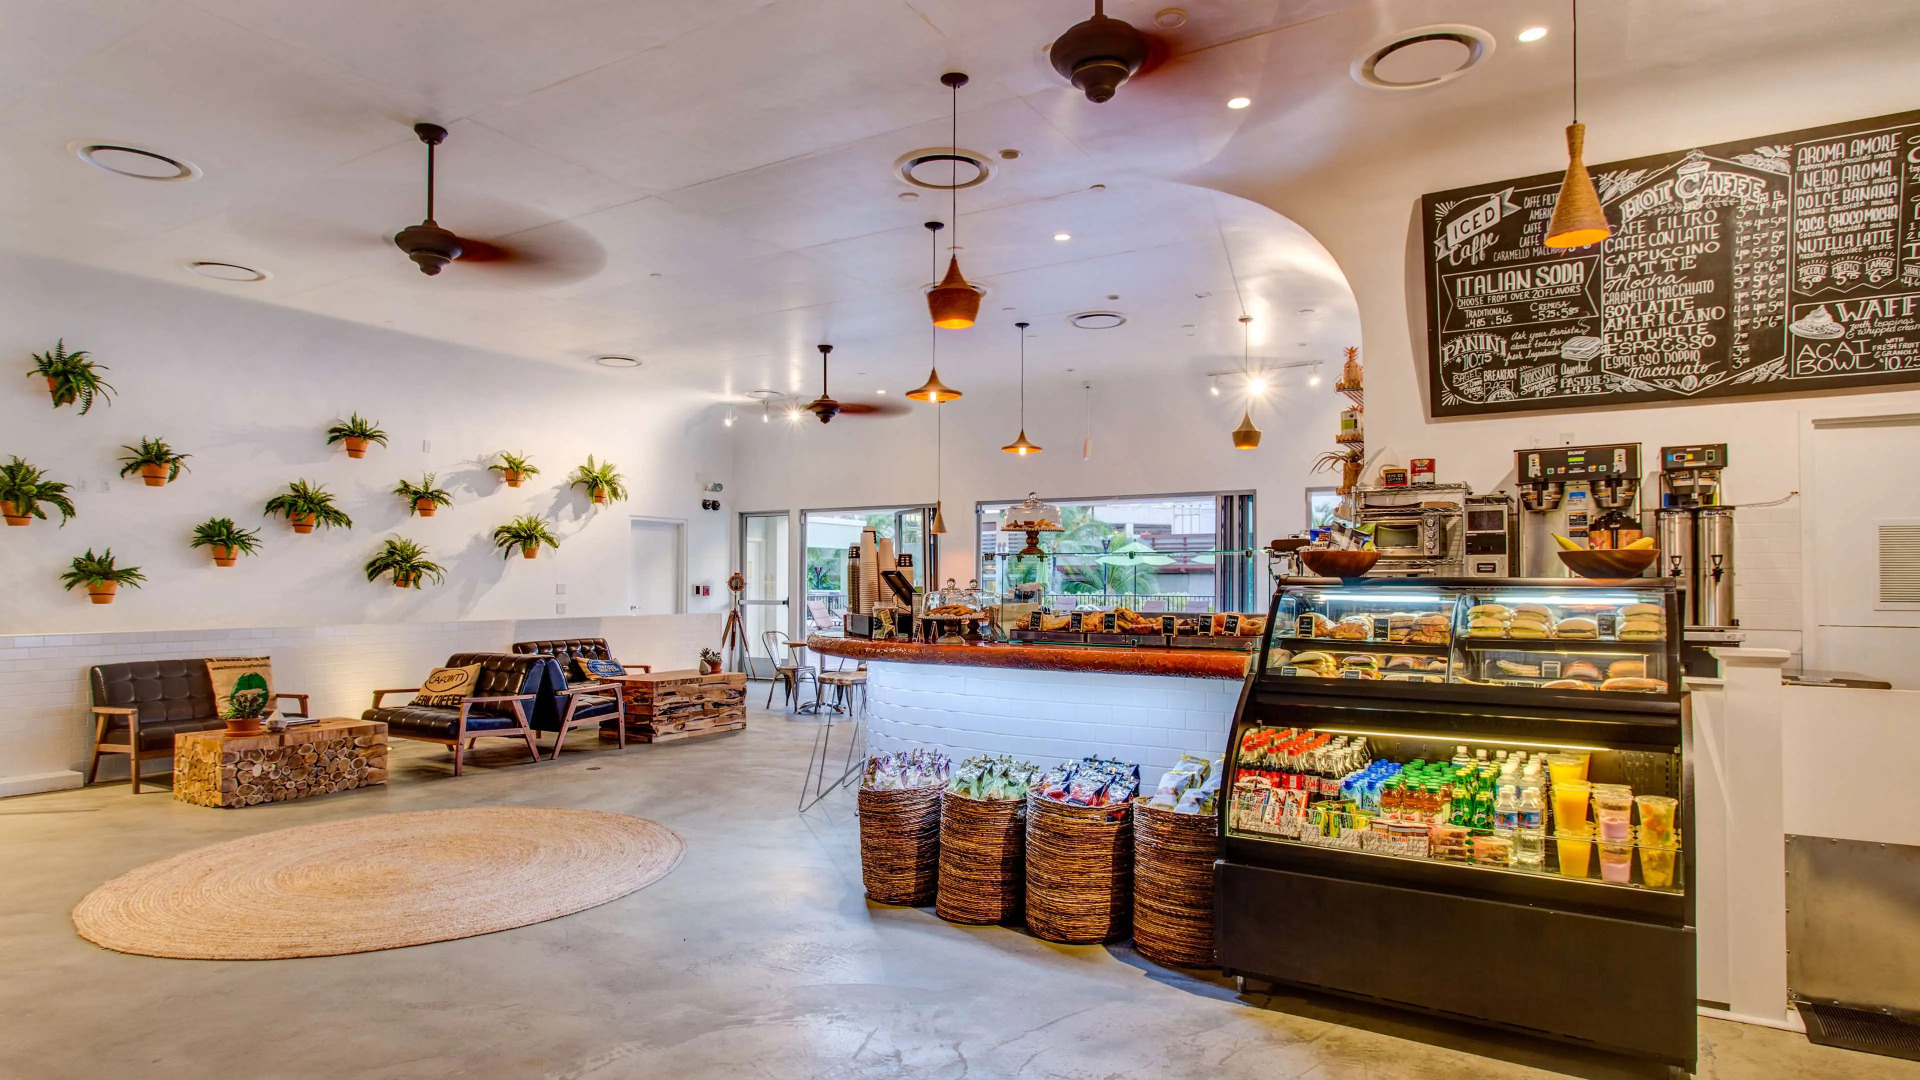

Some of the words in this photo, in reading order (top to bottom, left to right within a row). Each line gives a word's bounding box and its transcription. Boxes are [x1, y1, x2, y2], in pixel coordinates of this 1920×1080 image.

[1797, 142, 1846, 166] AROMA
[1850, 132, 1903, 158] AMORE
[1803, 168, 1839, 189] NERO
[1841, 159, 1892, 183] AROMA
[1523, 195, 1542, 210] CAFFE
[1541, 192, 1560, 207] FILT
[1618, 179, 1675, 223] HOT
[1674, 171, 1767, 204] CAFFE
[1758, 192, 1769, 203] M
[1773, 190, 1785, 201] L
[1797, 191, 1841, 210] DOLCE
[1842, 182, 1899, 204] BANANA
[1453, 206, 1495, 240] ICED
[1529, 206, 1554, 222] AMERIC
[1864, 205, 1899, 223] MOCHA
[1523, 221, 1543, 235] CAFFE
[1606, 219, 1648, 239] CAFE
[1657, 209, 1719, 231] FILTRO
[1831, 223, 1866, 234] chocolate
[1519, 234, 1540, 249] CAFFE
[1604, 234, 1648, 254] CAFFE
[1648, 229, 1675, 247] CON
[1678, 223, 1722, 244] LATTE
[1796, 233, 1854, 254] NUTELLA
[1856, 228, 1896, 248] LATTE
[1449, 232, 1500, 267] Caffe
[1493, 248, 1531, 263] CARAMELLO
[1604, 241, 1721, 266] CAPPUCCINO
[1605, 255, 1697, 280] LATTE
[1799, 265, 1827, 278] PICCOLO
[1832, 262, 1860, 276] MEDIO
[1865, 258, 1893, 272] LARGO
[1456, 268, 1532, 298] ITALIAN
[1535, 261, 1586, 287] SODA
[1603, 273, 1688, 293] Mocha
[1457, 296, 1484, 308] CHOOSE
[1487, 294, 1508, 305] FROM
[1510, 290, 1529, 301] OVER
[1532, 289, 1545, 300] 20
[1545, 284, 1581, 298] FLAVORS
[1602, 287, 1655, 307] CARAMELLO
[1657, 279, 1715, 300] MACCHIATO
[1464, 307, 1509, 320] TRADITIONAL
[1530, 301, 1571, 313] CREMOSA
[1604, 302, 1636, 319] SOY
[1636, 296, 1695, 316] LATTE
[1603, 306, 1726, 332] AMERICANO
[1873, 317, 1916, 332] toppings
[1604, 328, 1646, 345] FLAT
[1647, 322, 1710, 341] WHITE
[1857, 324, 1896, 338] whipped
[1443, 334, 1508, 363] PANINI
[1510, 340, 1533, 351] about
[1600, 334, 1717, 359] ESPRESSO
[1797, 339, 1873, 361] ACAI
[1872, 343, 1898, 352] FRESH
[1898, 341, 1920, 350] FRUIT
[1885, 337, 1905, 345] WITH
[1604, 351, 1661, 370] ESPRESSO
[1664, 349, 1701, 364] DOPPIO
[1881, 349, 1919, 358] GRANOLA
[1483, 367, 1519, 382] BREAKFAST
[1624, 360, 1721, 379] Macchiato
[1797, 355, 1876, 375] BOWL
[1452, 368, 1482, 385] BAGEL
[1560, 374, 1611, 389] PASTRIES
